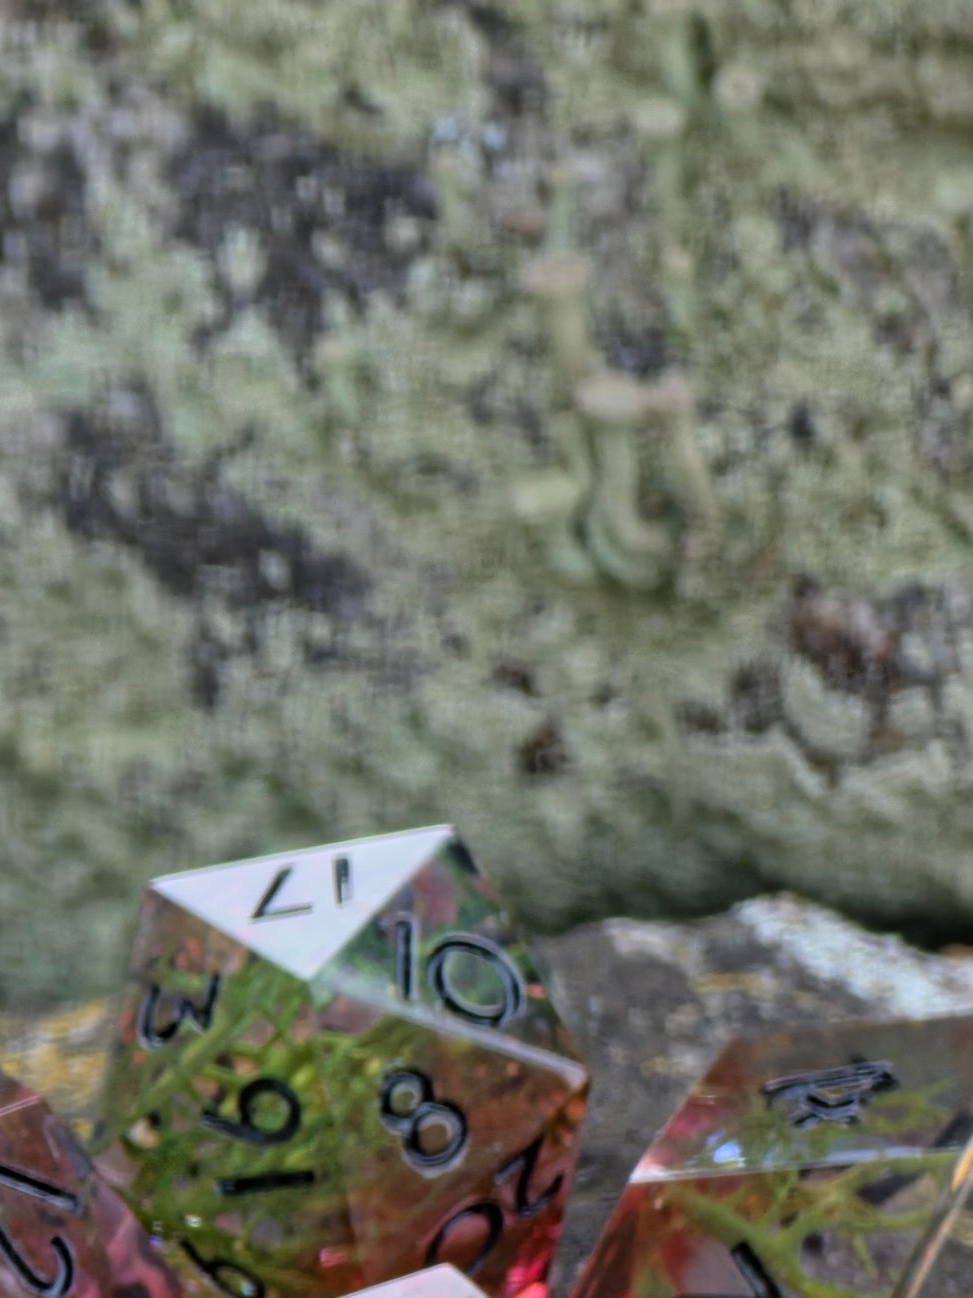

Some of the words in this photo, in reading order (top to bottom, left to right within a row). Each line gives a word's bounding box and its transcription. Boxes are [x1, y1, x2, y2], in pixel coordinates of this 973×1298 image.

[252, 856, 352, 925] 17
[392, 912, 527, 1028] 10
[380, 1068, 469, 1176] 8
